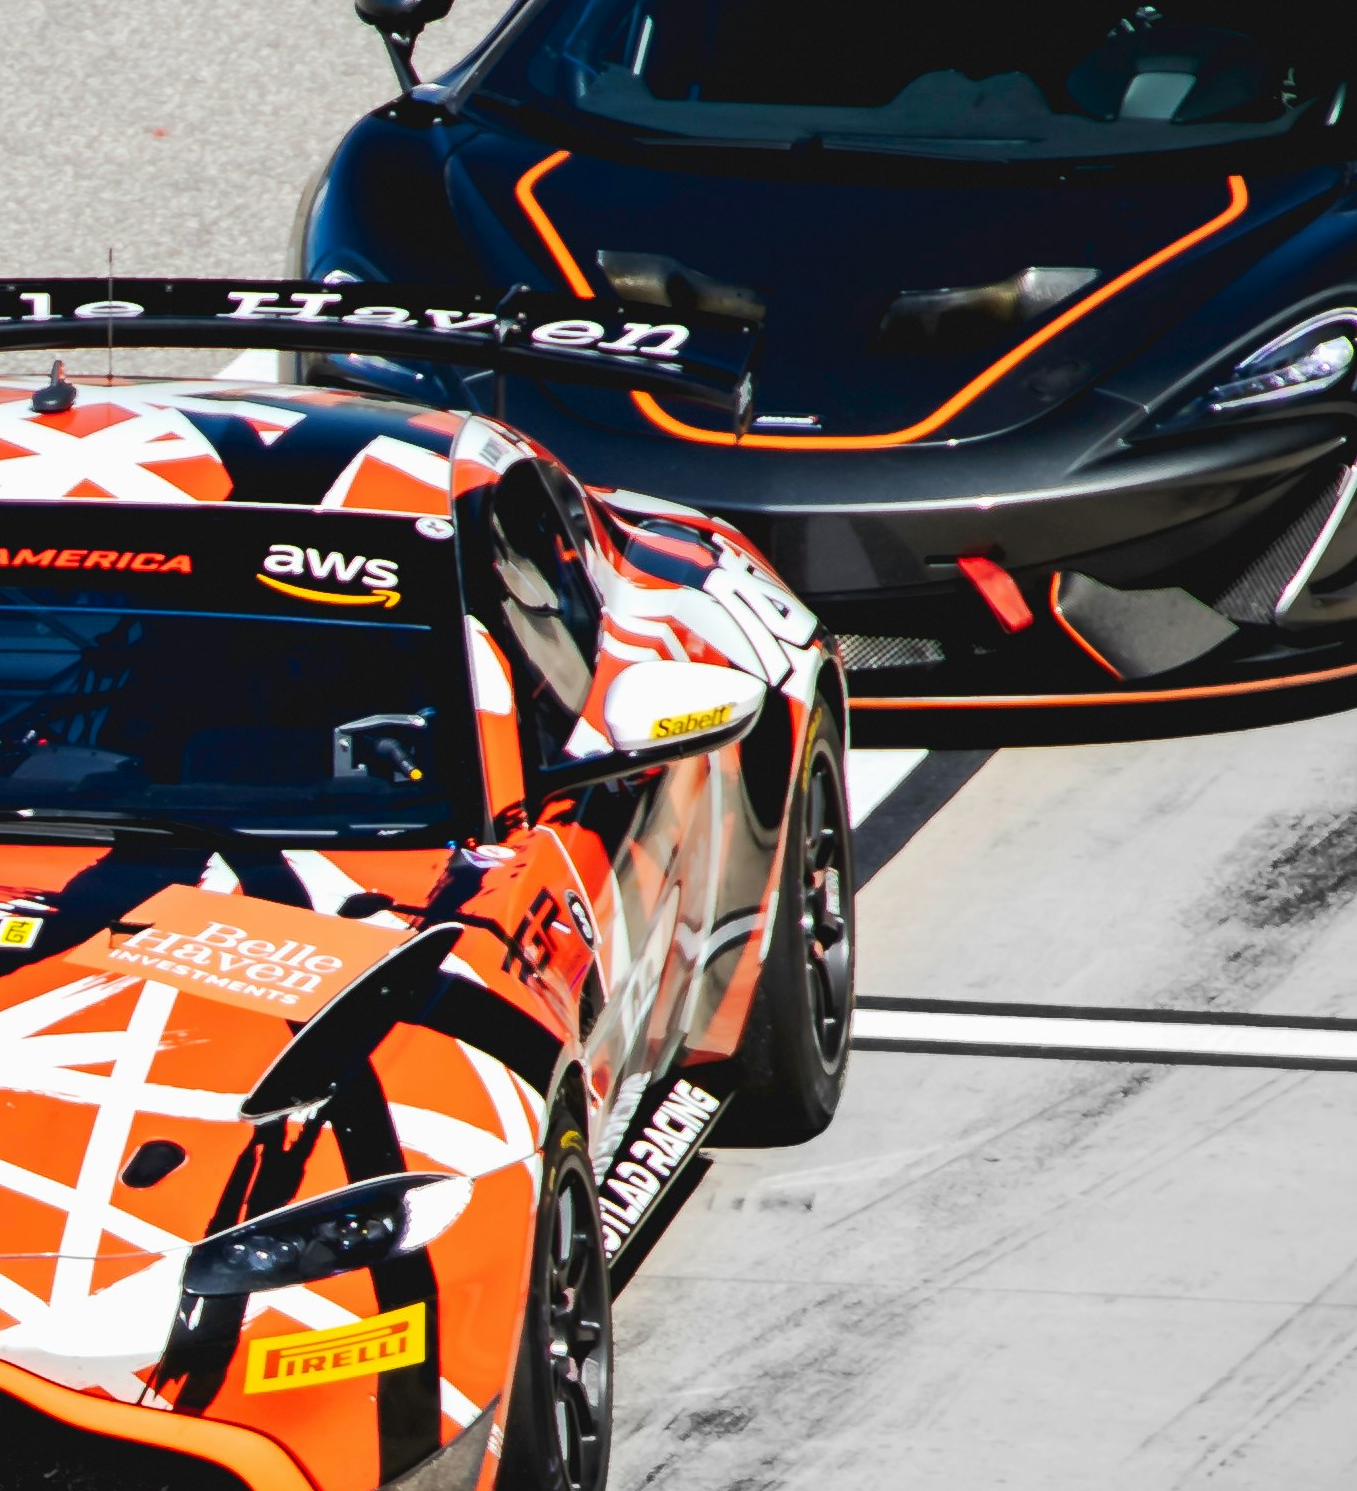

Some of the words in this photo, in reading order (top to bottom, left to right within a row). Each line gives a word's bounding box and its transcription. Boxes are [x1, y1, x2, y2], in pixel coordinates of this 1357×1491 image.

[218, 291, 690, 357] Haven
[263, 543, 400, 589] aws
[108, 948, 300, 1006] INVESTMENTS
[121, 927, 323, 994] Haven
[190, 920, 344, 974] Belle
[629, 1079, 722, 1178] RACING
[598, 1161, 661, 1259] OTLAD
[263, 1320, 410, 1380] PIRELLI
